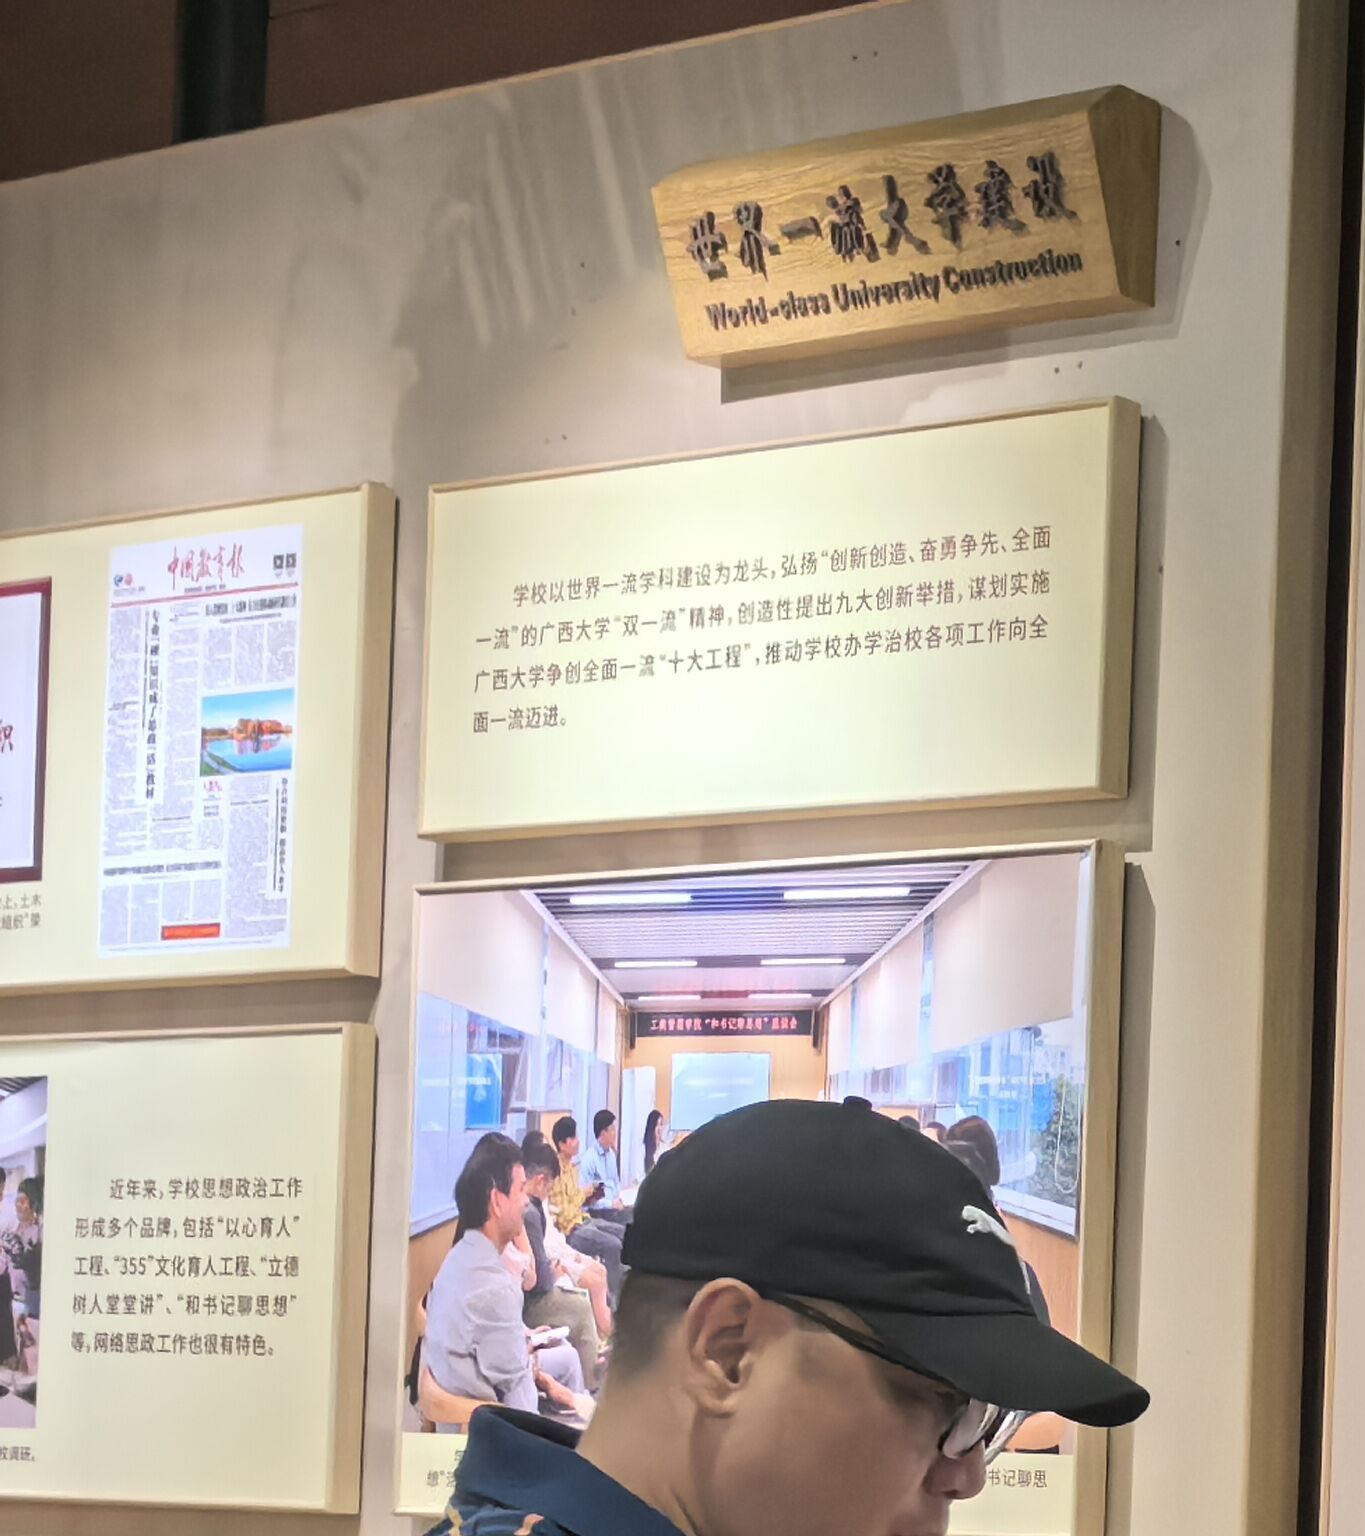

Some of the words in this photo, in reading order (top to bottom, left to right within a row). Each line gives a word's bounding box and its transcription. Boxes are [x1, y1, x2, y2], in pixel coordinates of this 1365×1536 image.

[706, 288, 831, 331] World-class
[832, 270, 941, 313] University
[943, 247, 1083, 295] Construction
[473, 703, 568, 735] 面一流迈进。
[109, 1177, 303, 1201] 近年来，学校思想政治工作
